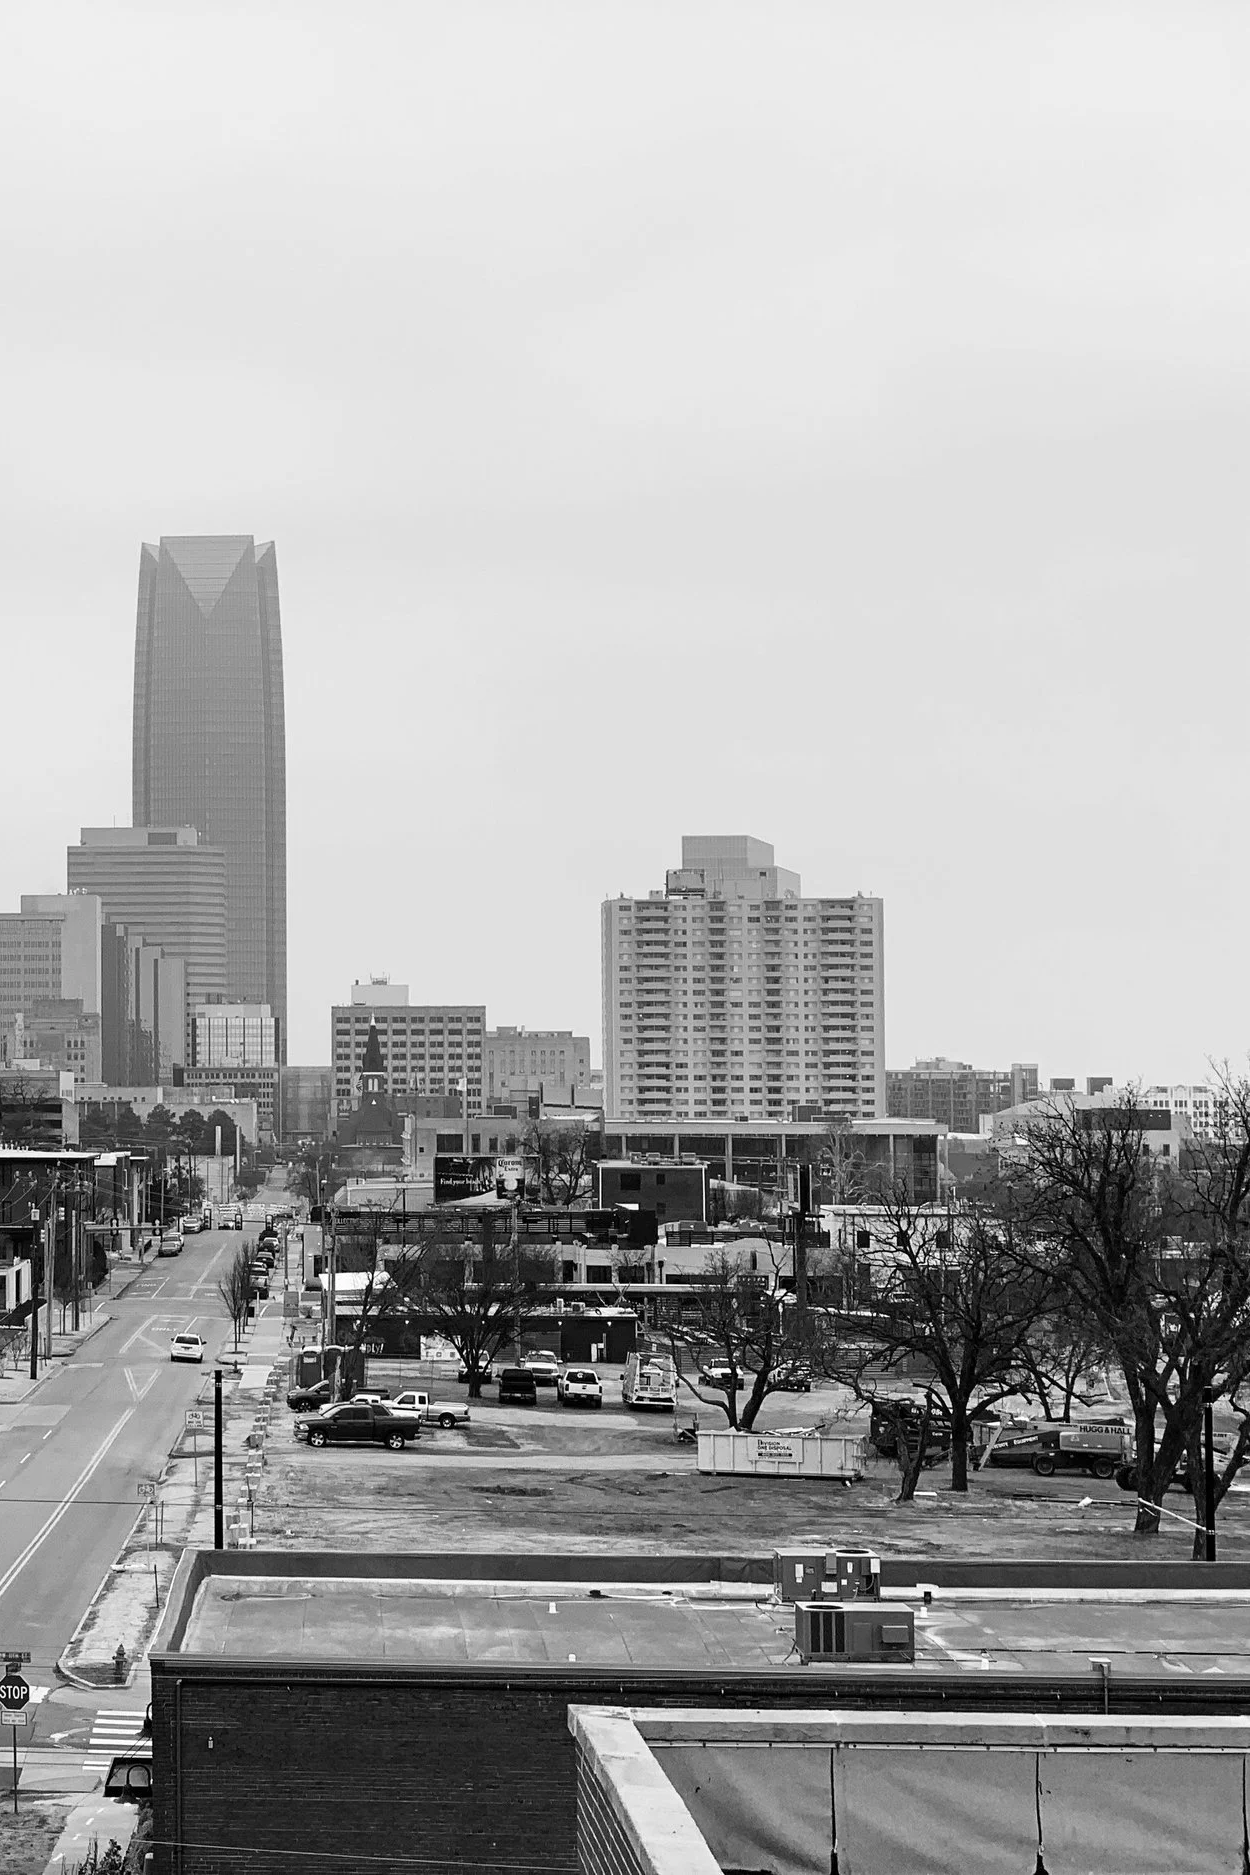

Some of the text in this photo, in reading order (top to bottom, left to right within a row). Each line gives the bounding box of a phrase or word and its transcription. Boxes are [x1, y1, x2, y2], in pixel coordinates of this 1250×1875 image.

[498, 1159, 522, 1167] Corona
[1079, 1425, 1104, 1433] HUGG
[1111, 1427, 1133, 1435] HALL
[0, 1685, 28, 1699] STOP
